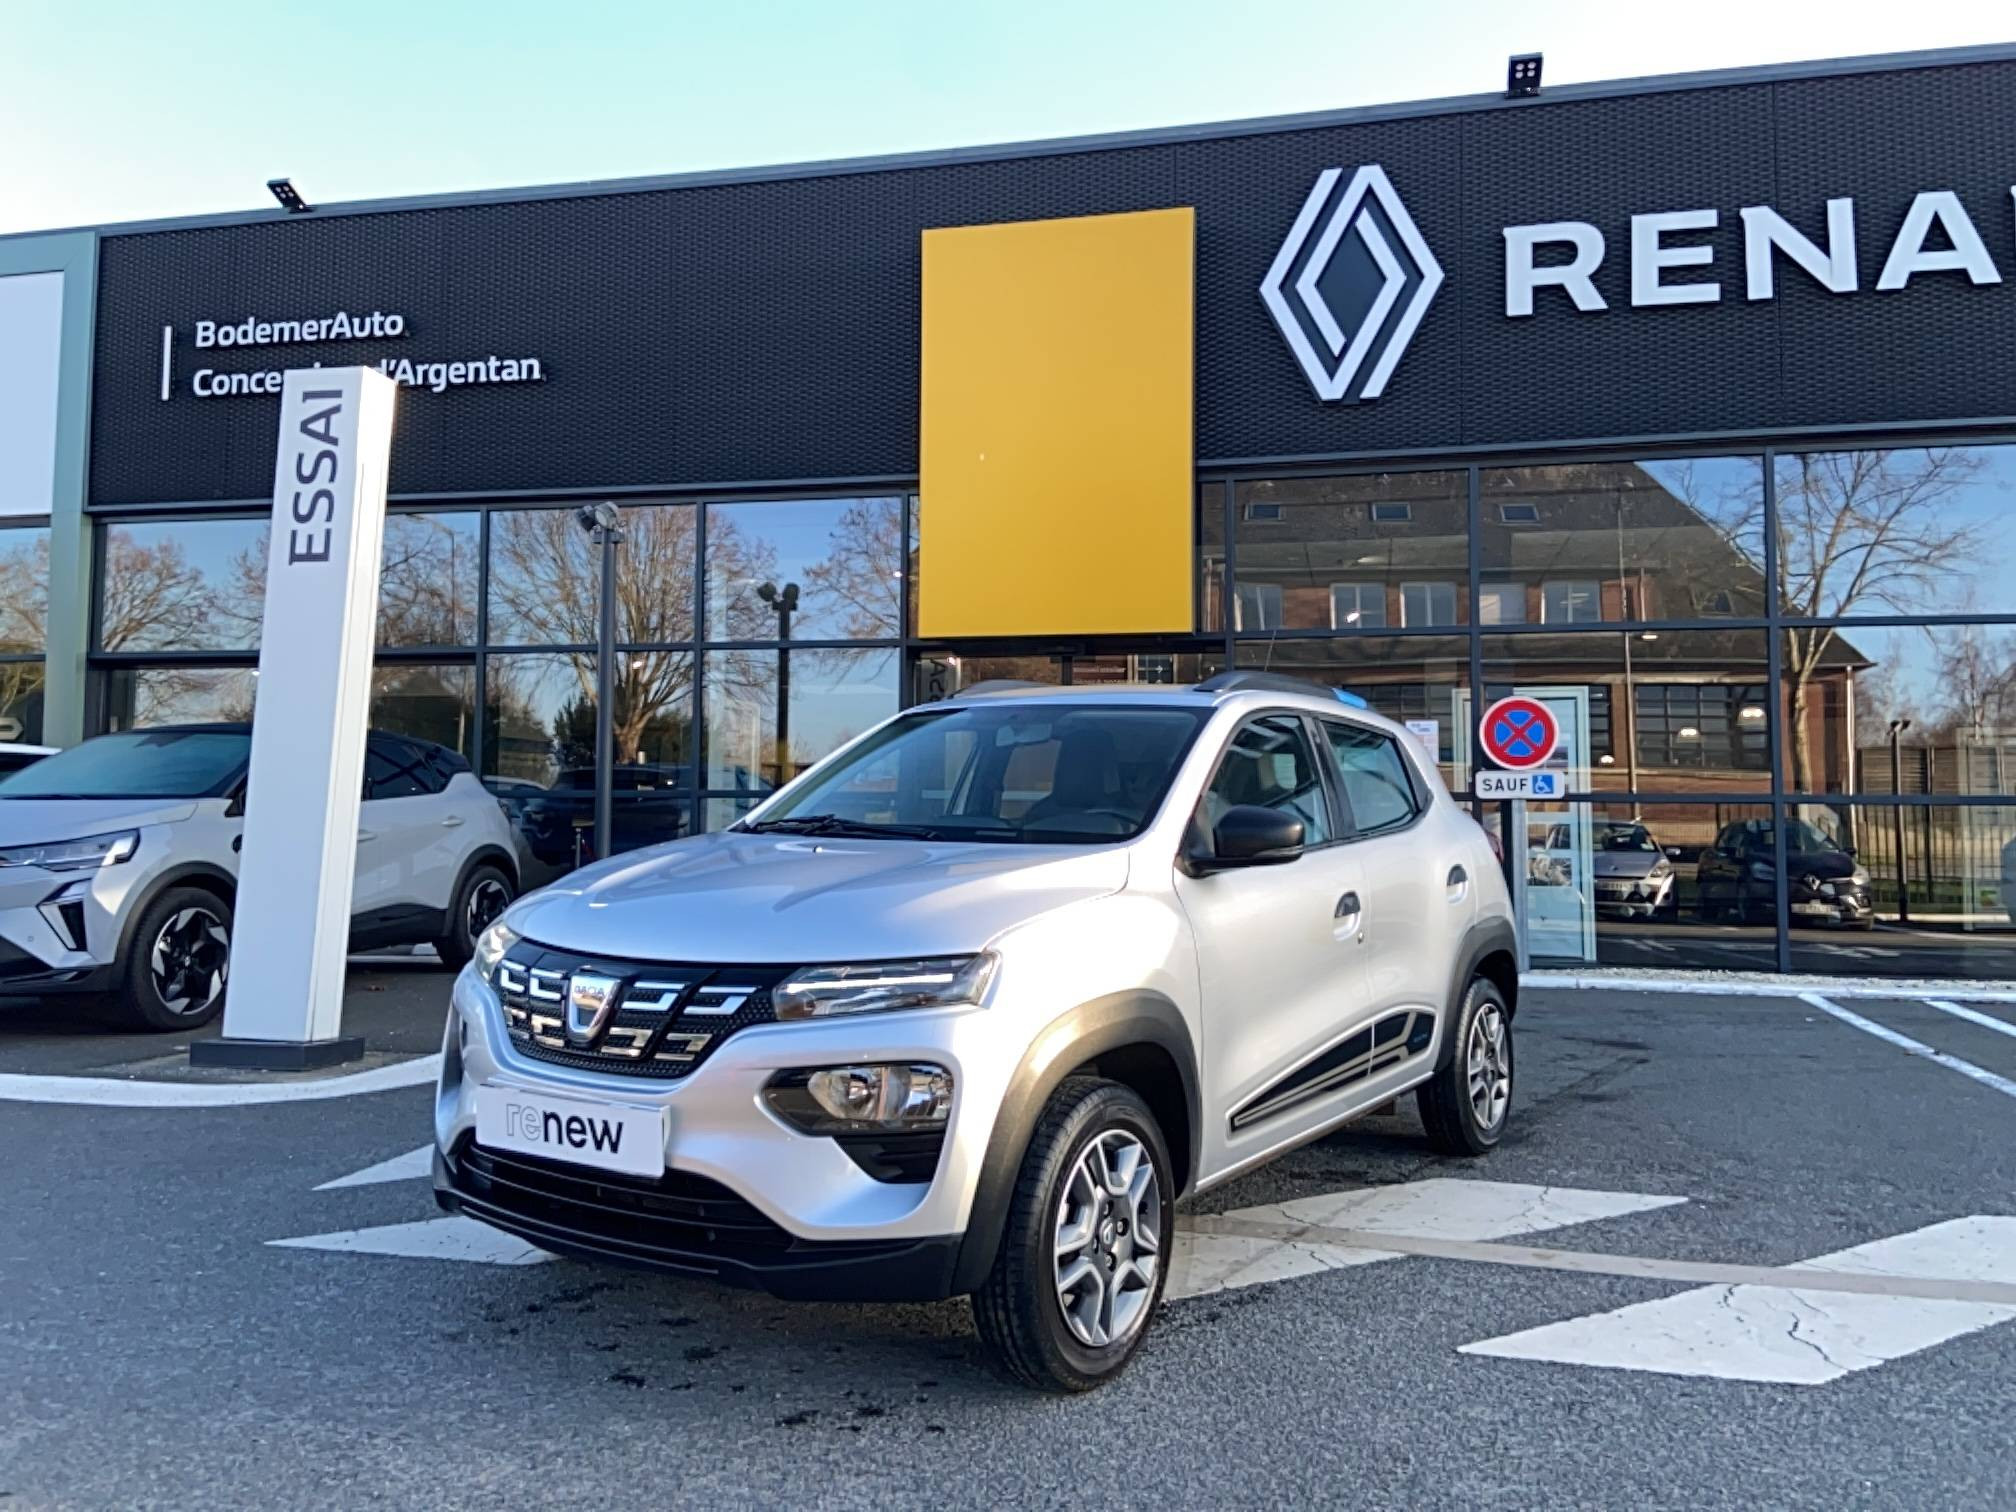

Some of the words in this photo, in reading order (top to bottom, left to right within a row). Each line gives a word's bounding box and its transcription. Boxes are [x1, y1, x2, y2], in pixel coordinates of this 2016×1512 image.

[1502, 184, 2016, 317] RENA
[195, 311, 404, 348] BodemerAuto
[193, 362, 320, 397] Conce
[288, 389, 343, 566] ESSAI
[1482, 777, 1528, 792] SAUF
[505, 1102, 624, 1154] renew
